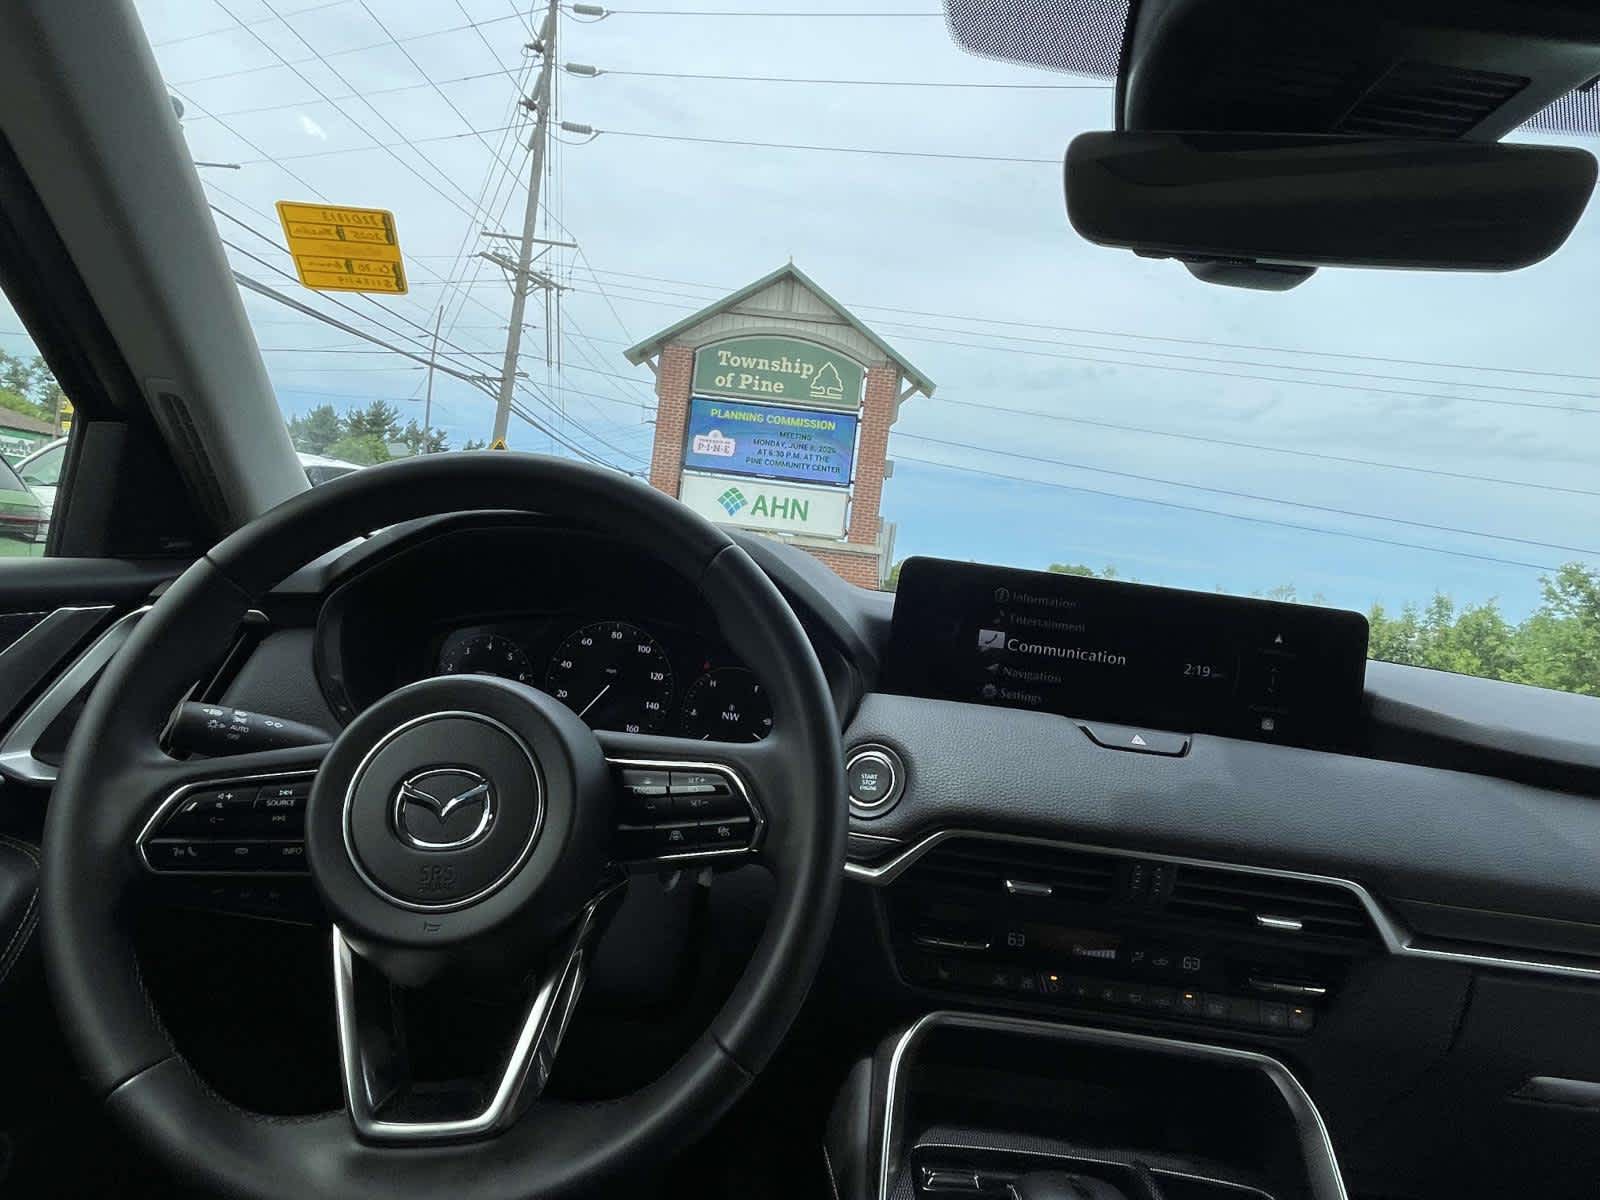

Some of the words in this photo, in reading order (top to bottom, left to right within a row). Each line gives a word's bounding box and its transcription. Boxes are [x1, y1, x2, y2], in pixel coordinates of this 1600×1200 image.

[718, 350, 814, 378] Township
[714, 373, 736, 388] of
[738, 374, 785, 394] Pine
[710, 408, 764, 424] PLANNING
[766, 414, 837, 431] COMMISSION
[778, 431, 813, 441] MEETING
[788, 441, 810, 451] JUNE
[756, 448, 769, 457] AT
[802, 453, 814, 462] AT
[815, 454, 831, 464] THE
[745, 457, 763, 467] PINE
[764, 459, 811, 472] COMMUNITY
[812, 463, 841, 474] CENTER
[750, 494, 809, 522] AHN
[611, 631, 623, 640] 80
[580, 637, 593, 646] 60
[637, 644, 651, 654] 100
[1007, 638, 1128, 667] Communication
[560, 660, 573, 669] 40
[1183, 663, 1212, 679] 2:19
[650, 672, 664, 681] 120
[556, 689, 568, 698] 20
[646, 701, 660, 711] 140
[721, 711, 740, 722] NW
[230, 723, 250, 734] AUTO
[625, 724, 640, 734] 160
[265, 798, 296, 808] SOURCE
